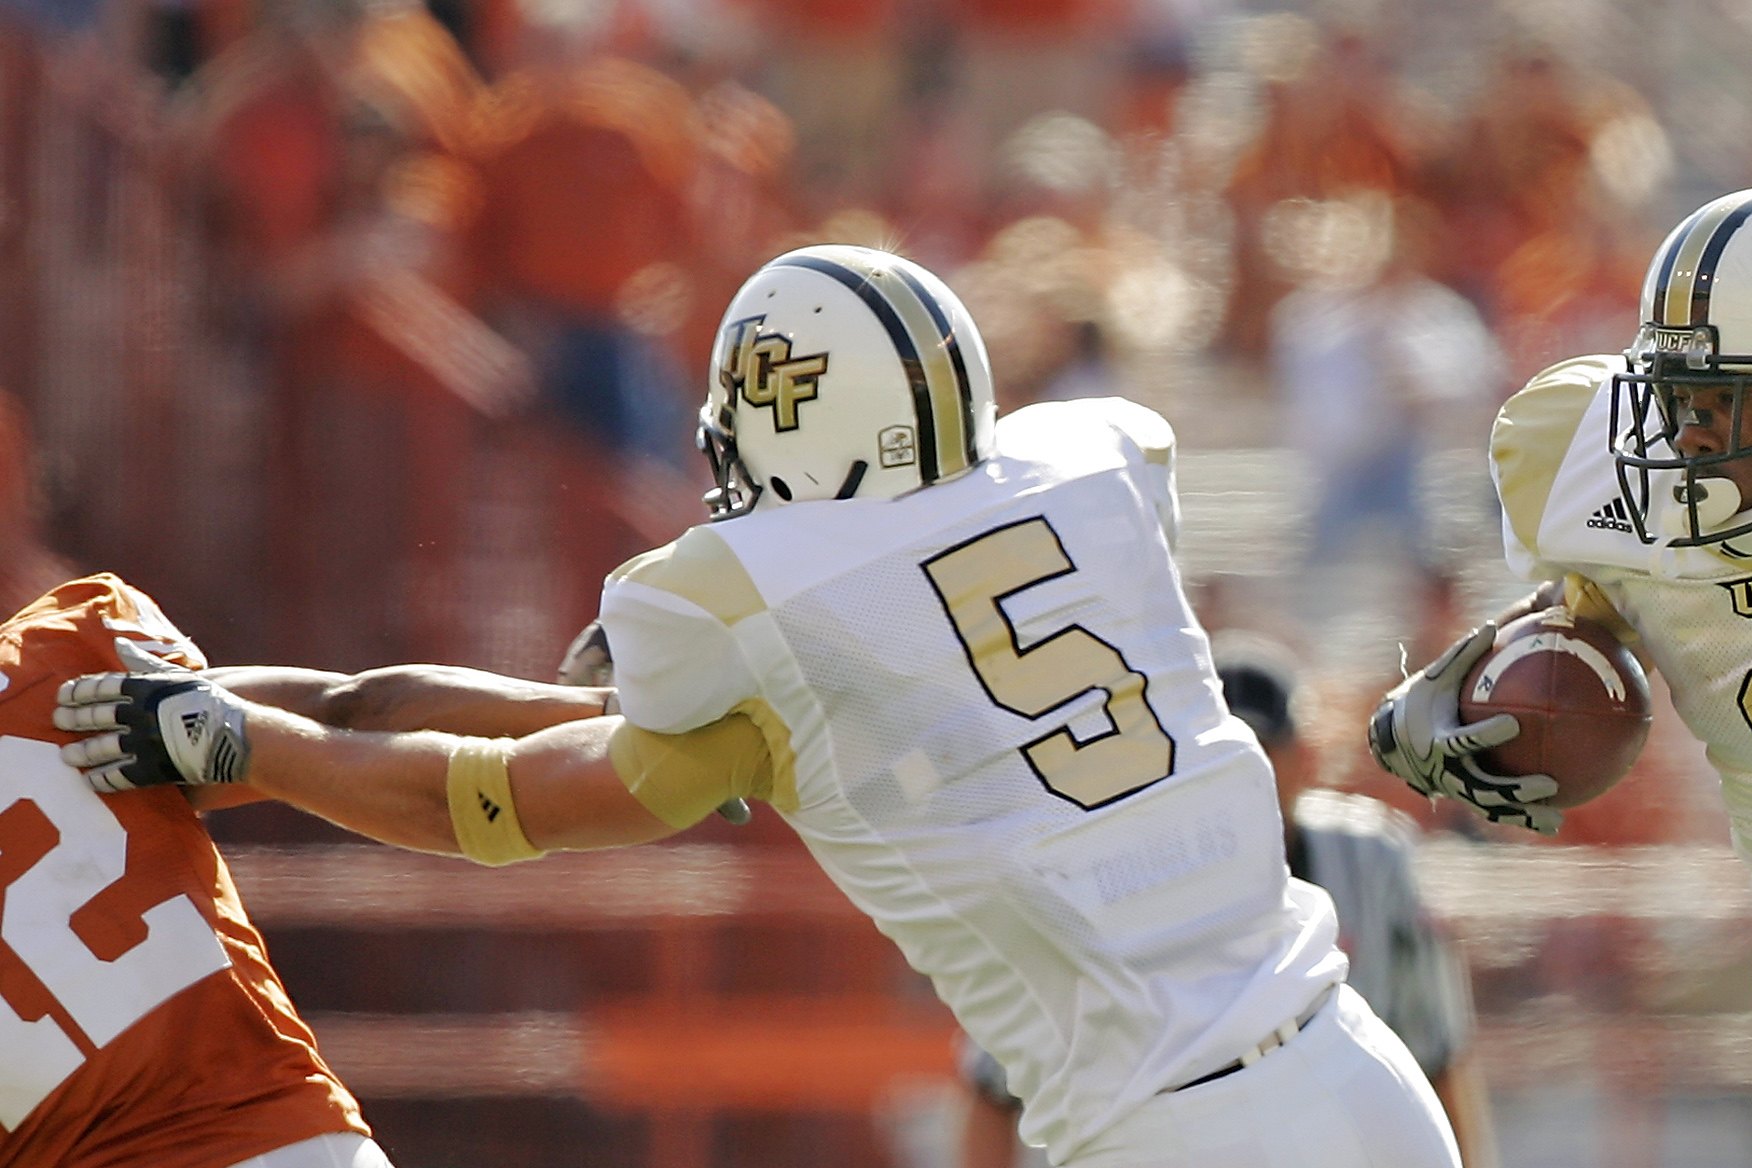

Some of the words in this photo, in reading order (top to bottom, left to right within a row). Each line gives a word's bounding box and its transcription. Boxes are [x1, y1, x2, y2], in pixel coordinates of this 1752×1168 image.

[721, 314, 829, 432] UCF
[1587, 519, 1632, 533] adidas
[920, 514, 1175, 811] 5
